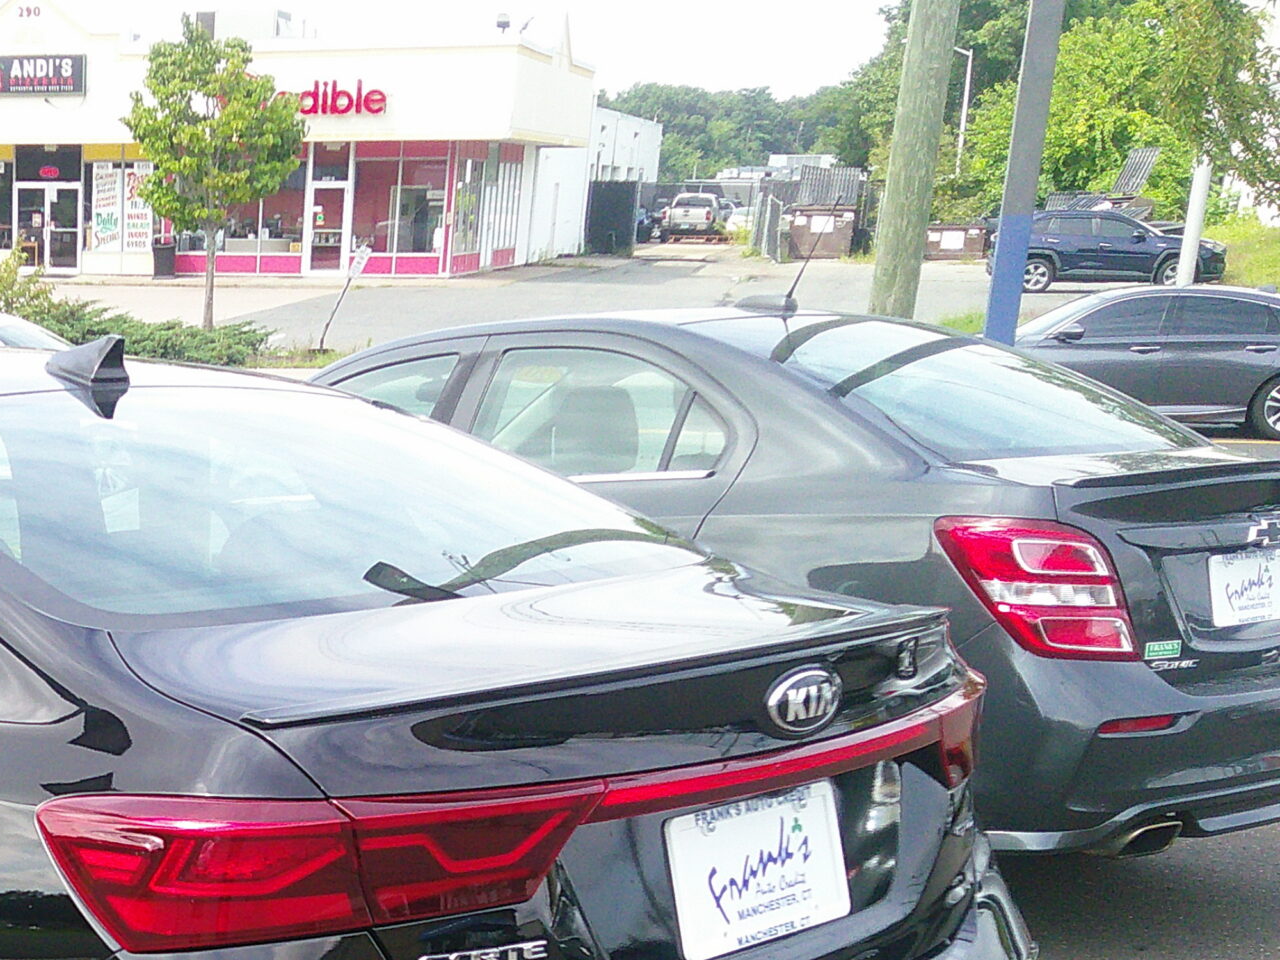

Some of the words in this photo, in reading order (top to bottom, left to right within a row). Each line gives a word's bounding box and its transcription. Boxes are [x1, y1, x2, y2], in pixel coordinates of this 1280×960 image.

[18, 6, 41, 18] 290
[10, 58, 73, 78] ANDI'S
[278, 79, 387, 115] dible
[95, 212, 118, 231] Daily
[786, 682, 833, 722] KIA
[802, 888, 813, 901] CT
[800, 915, 811, 927] CT
